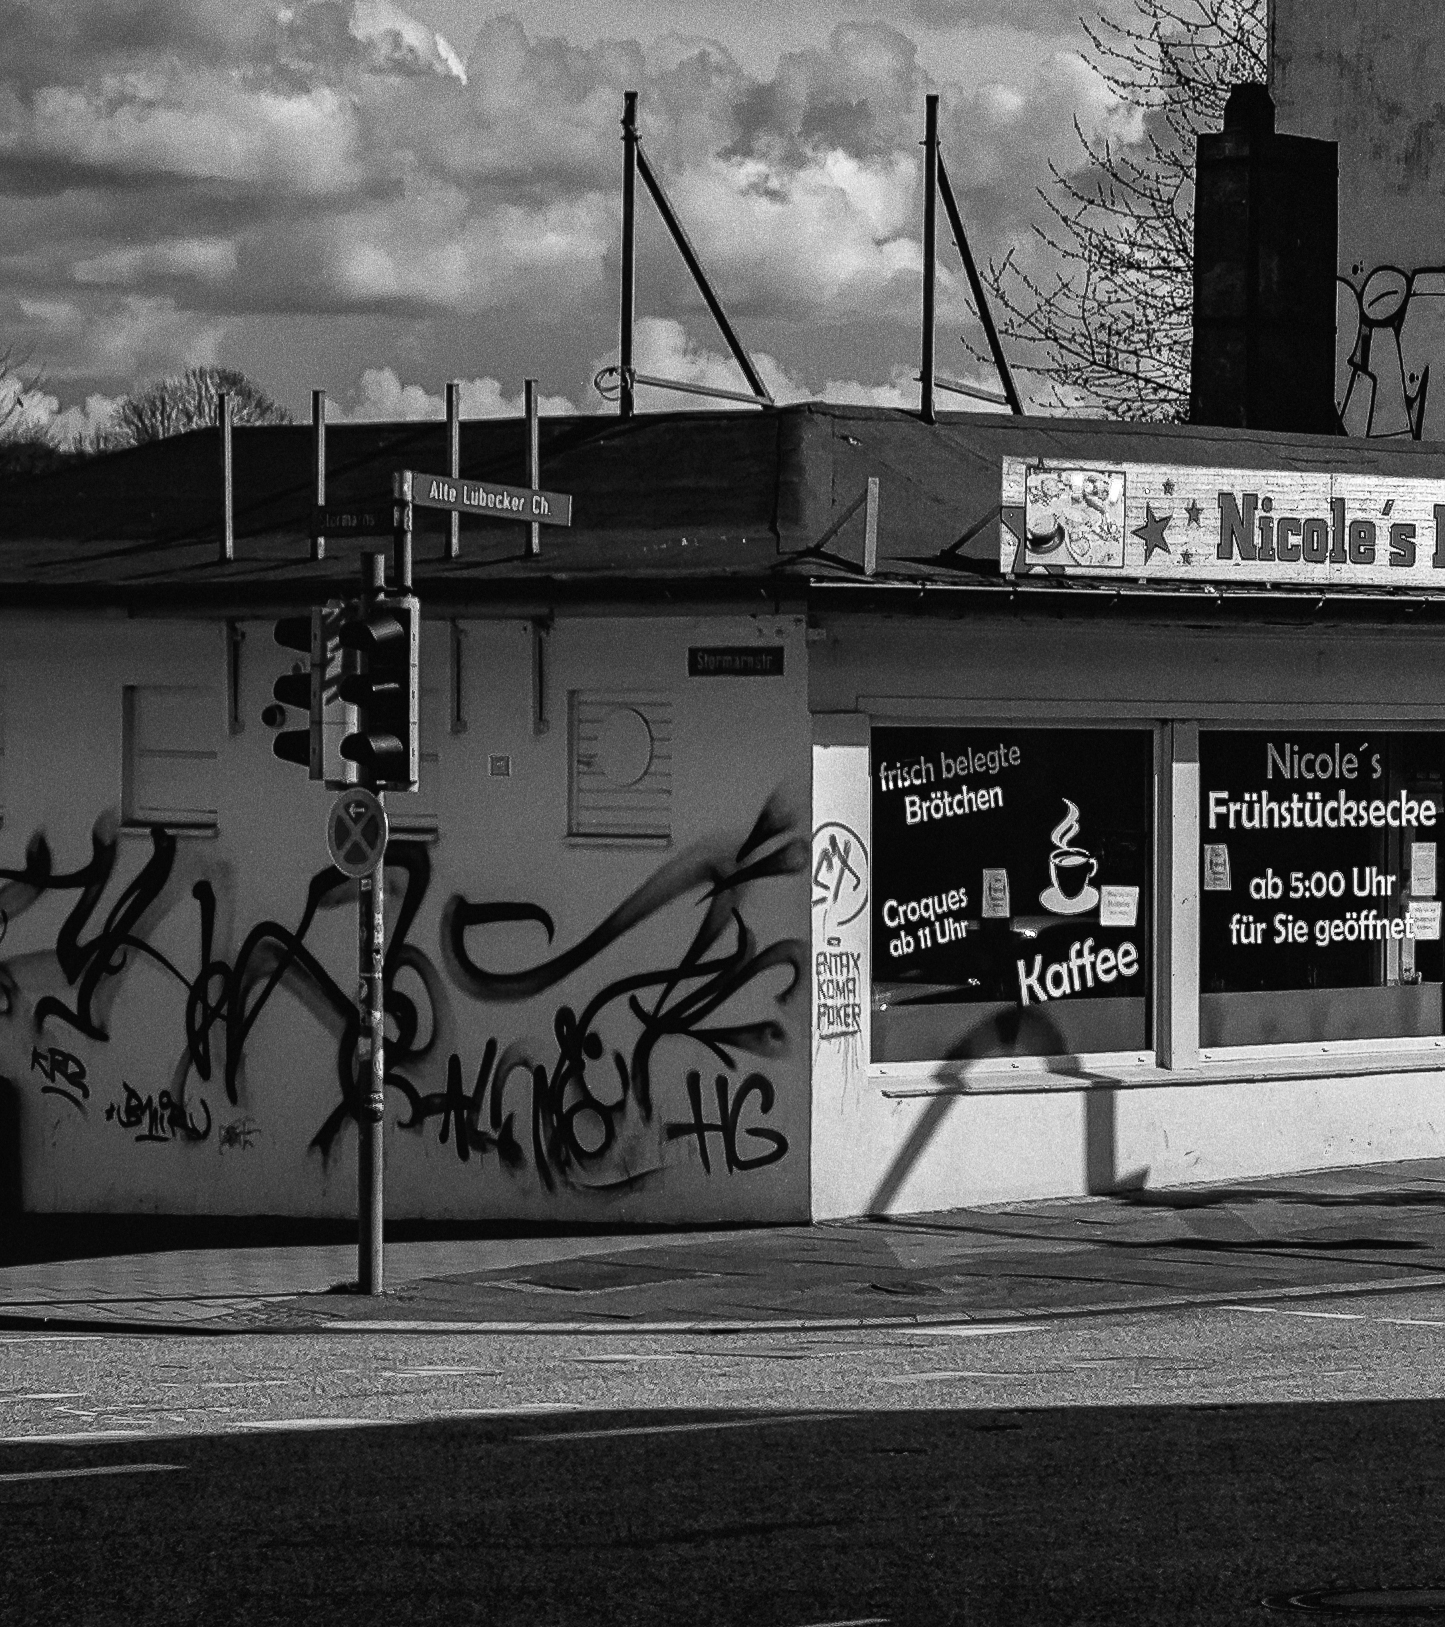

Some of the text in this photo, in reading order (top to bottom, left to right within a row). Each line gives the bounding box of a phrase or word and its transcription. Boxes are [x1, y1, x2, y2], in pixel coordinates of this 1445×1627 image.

[429, 480, 552, 515] Alte Lübecker Ch.
[879, 744, 1021, 791] frisch belegte
[904, 785, 1004, 825] Brötchen
[1208, 789, 1437, 830] Frühstücksecke
[1249, 868, 1284, 900] ab
[1289, 870, 1346, 899] 5:00
[1353, 866, 1396, 897] Uhr
[883, 887, 968, 928] Croques
[889, 917, 969, 958] ab 11 Uhr
[1229, 913, 1267, 945] für
[1274, 912, 1308, 944] Sie
[1314, 909, 1415, 947] geöffnet
[1017, 937, 1138, 1006] Kaffee
[817, 1002, 863, 1033] POKER
